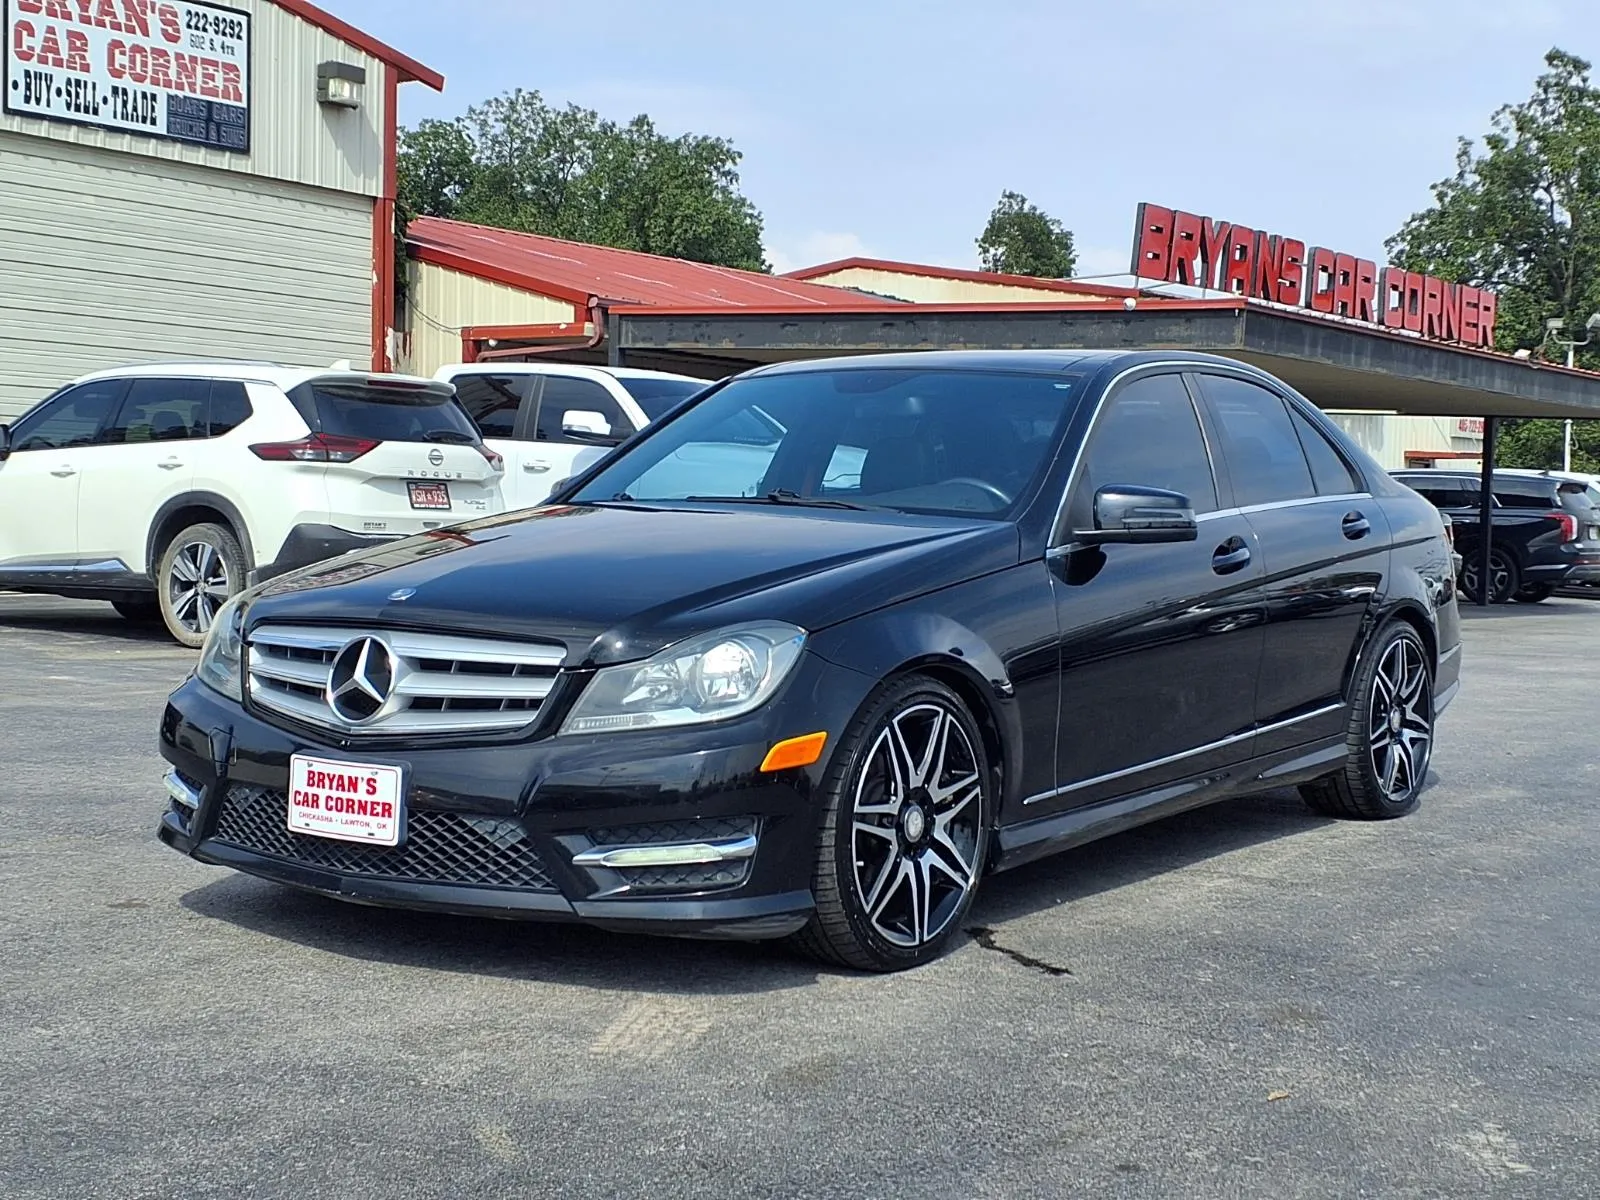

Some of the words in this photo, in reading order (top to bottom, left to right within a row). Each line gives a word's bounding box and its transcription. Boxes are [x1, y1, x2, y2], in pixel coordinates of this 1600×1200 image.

[185, 9, 243, 41] 222-9292
[13, 20, 91, 73] CAR
[107, 39, 243, 103] CORNER
[23, 69, 53, 108] BUY
[65, 77, 99, 116] SELL
[111, 85, 158, 126] TRADE
[1131, 202, 1304, 305] BRYANS
[1305, 246, 1376, 322] CAR
[1379, 266, 1496, 347] CORNER
[408, 470, 462, 478] ROGUE
[306, 770, 377, 795] BRYAN'S
[294, 790, 320, 809] CAR
[325, 795, 393, 819] CORNER
[298, 812, 333, 823] CHICKASHA
